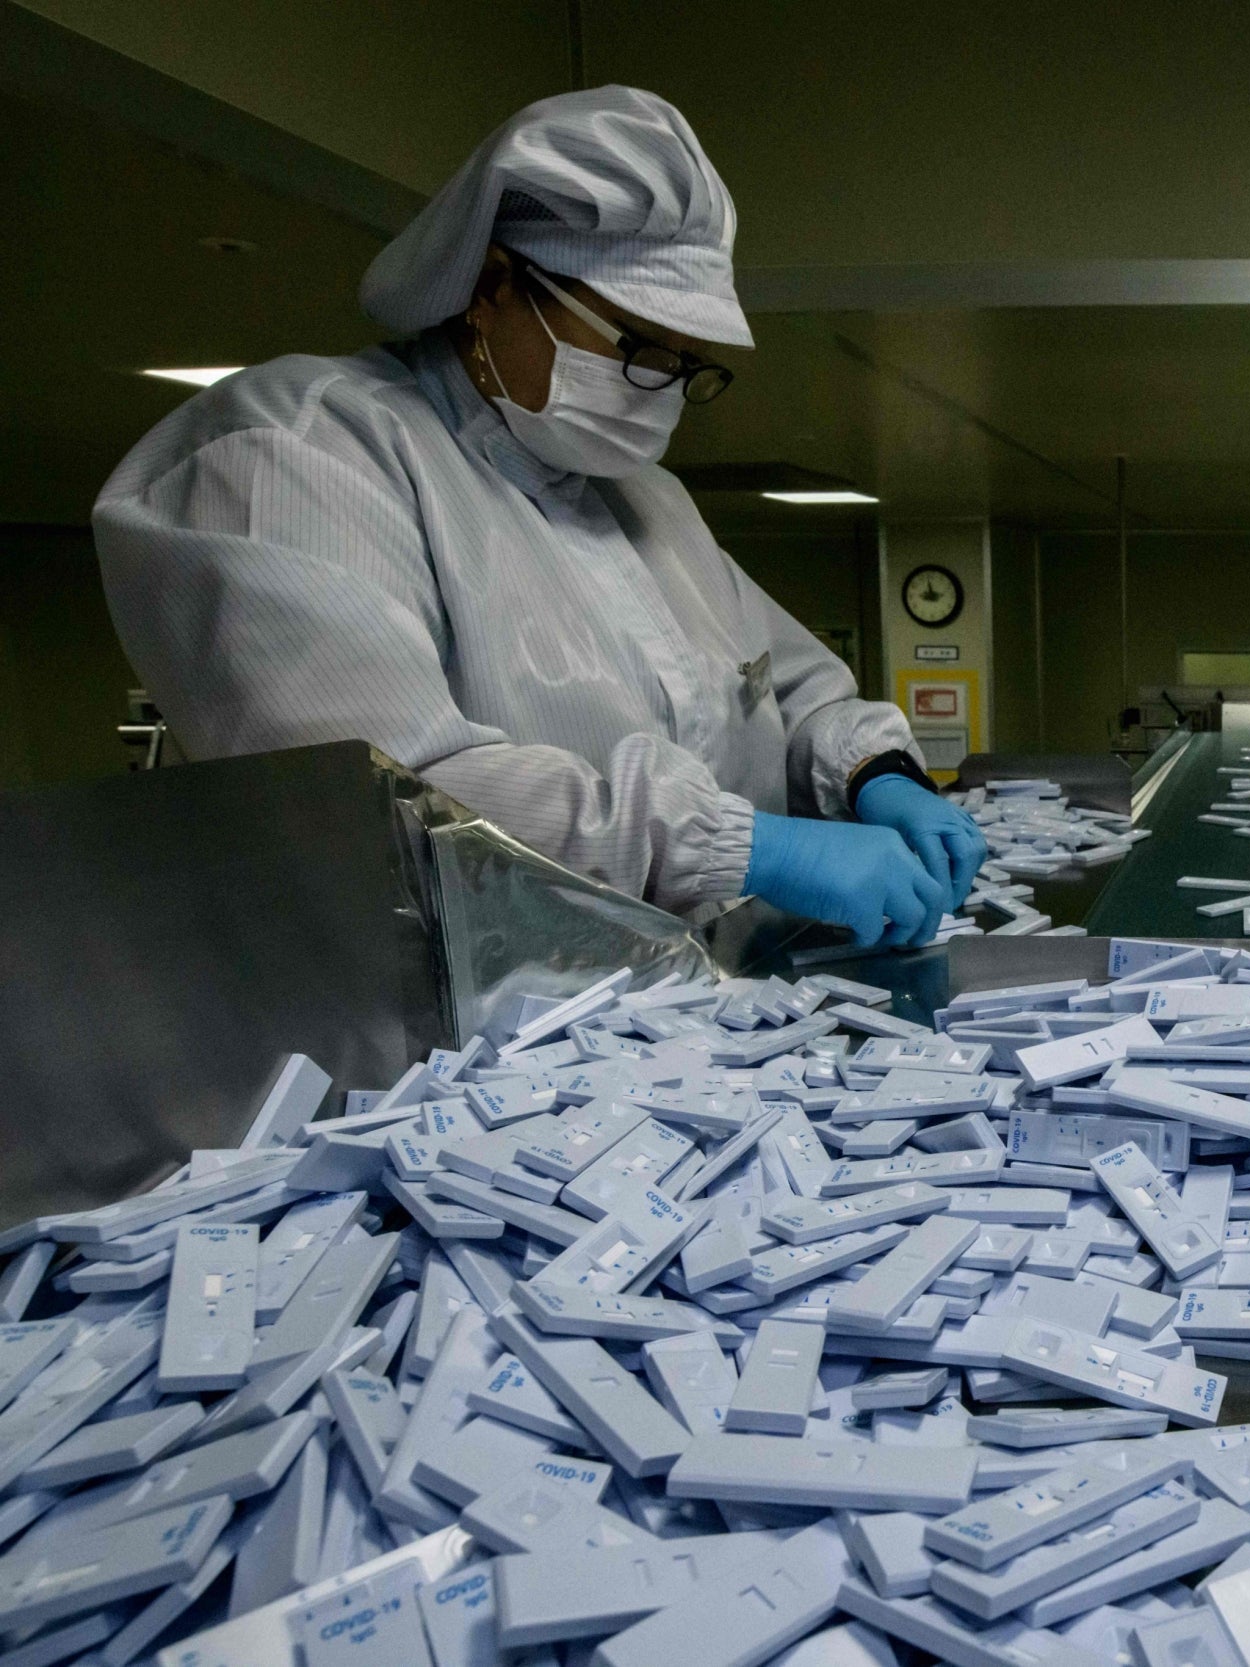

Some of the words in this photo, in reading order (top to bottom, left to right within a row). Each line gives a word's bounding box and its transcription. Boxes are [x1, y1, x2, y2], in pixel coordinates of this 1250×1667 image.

[1114, 945, 1122, 973] COVID-19
[1149, 991, 1161, 1015] COVID-19
[478, 1088, 503, 1114] COVID-19
[432, 1106, 447, 1134] COVID-19
[651, 1123, 687, 1144] COVID-19
[1012, 1117, 1022, 1154] COVID-19
[1021, 1131, 1029, 1144] IgG
[401, 1138, 422, 1165] COVID-19
[530, 1146, 573, 1164] COVID-19
[1099, 1147, 1134, 1166] COVID-19
[1114, 1158, 1127, 1167] IgG
[646, 1190, 684, 1223] COVID-19
[650, 1206, 664, 1219] IgG
[1182, 1293, 1198, 1322] COVID-19
[489, 1360, 520, 1393] COVID-19
[1193, 1385, 1203, 1398] IgG
[1200, 1378, 1217, 1413] COVID-19
[435, 1574, 488, 1605] COVID-
[319, 1597, 401, 1641] COVID-19
[349, 1626, 378, 1644] IgG
